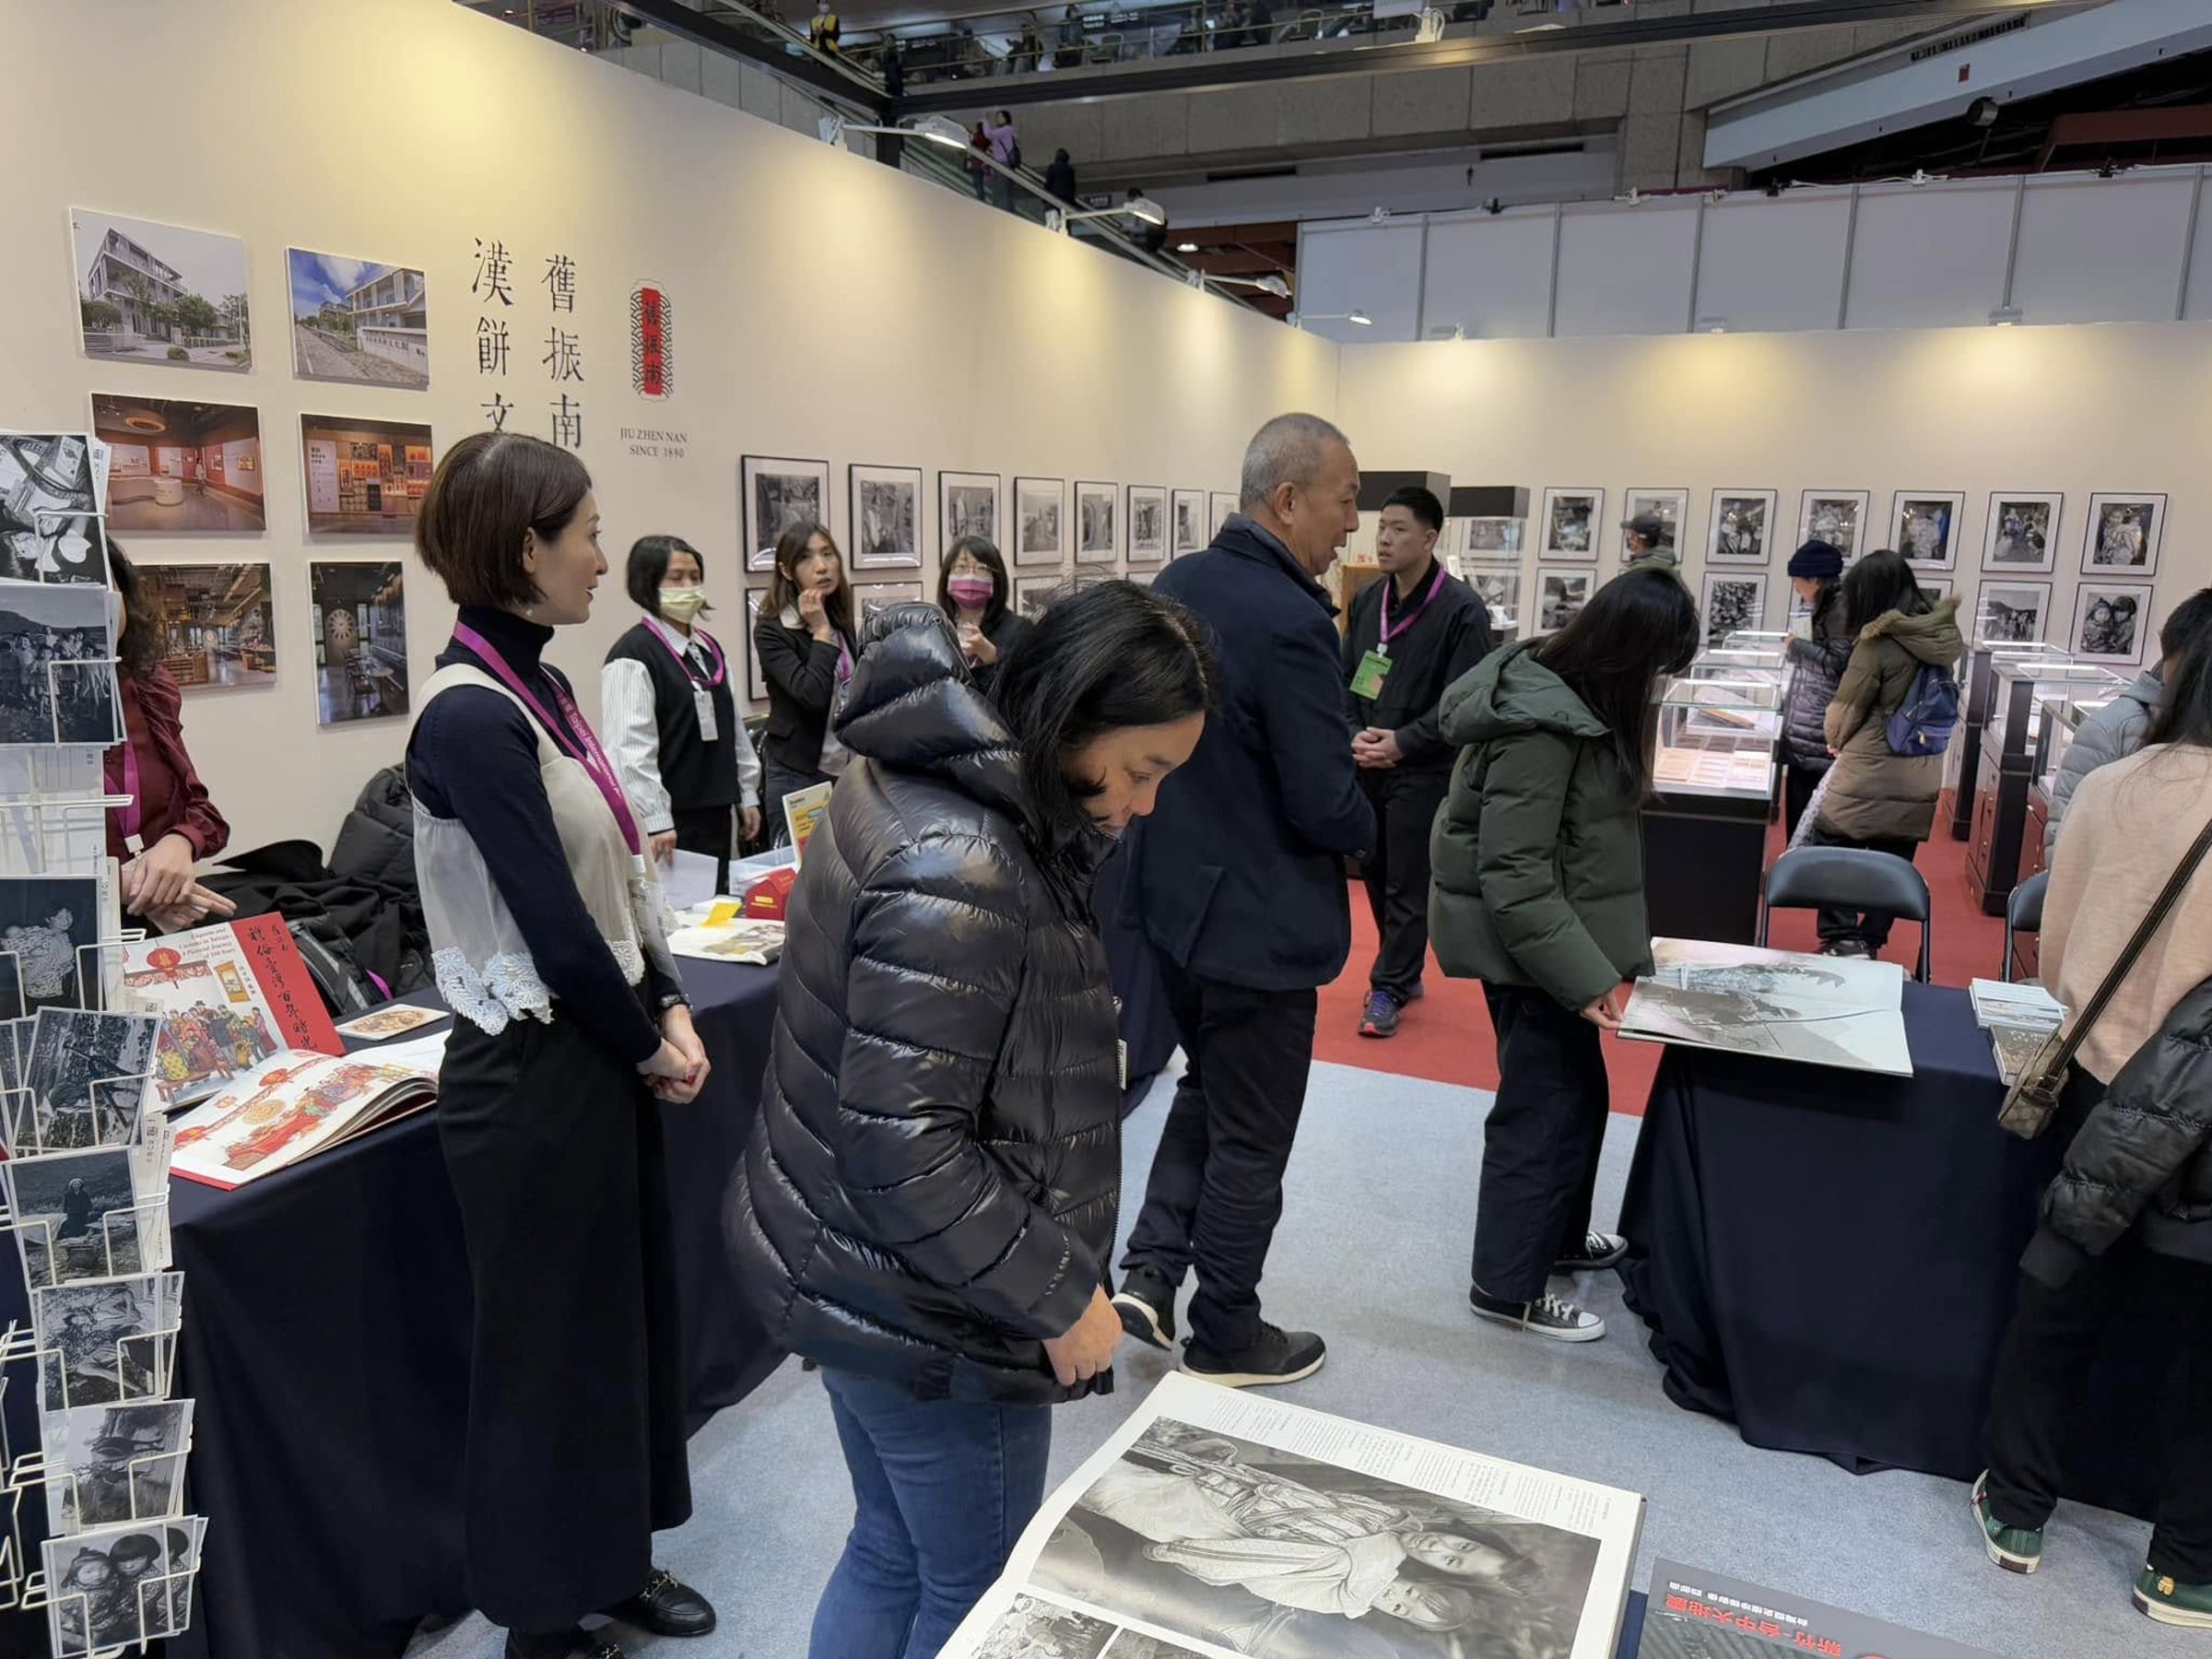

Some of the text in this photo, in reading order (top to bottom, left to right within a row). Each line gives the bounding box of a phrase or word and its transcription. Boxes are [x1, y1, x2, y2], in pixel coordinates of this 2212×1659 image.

[472, 237, 514, 433] 漢餅文
[541, 253, 584, 450] 舊振南
[619, 427, 688, 444] JIU ZHEN NAN
[629, 444, 685, 459] SINCE 1890
